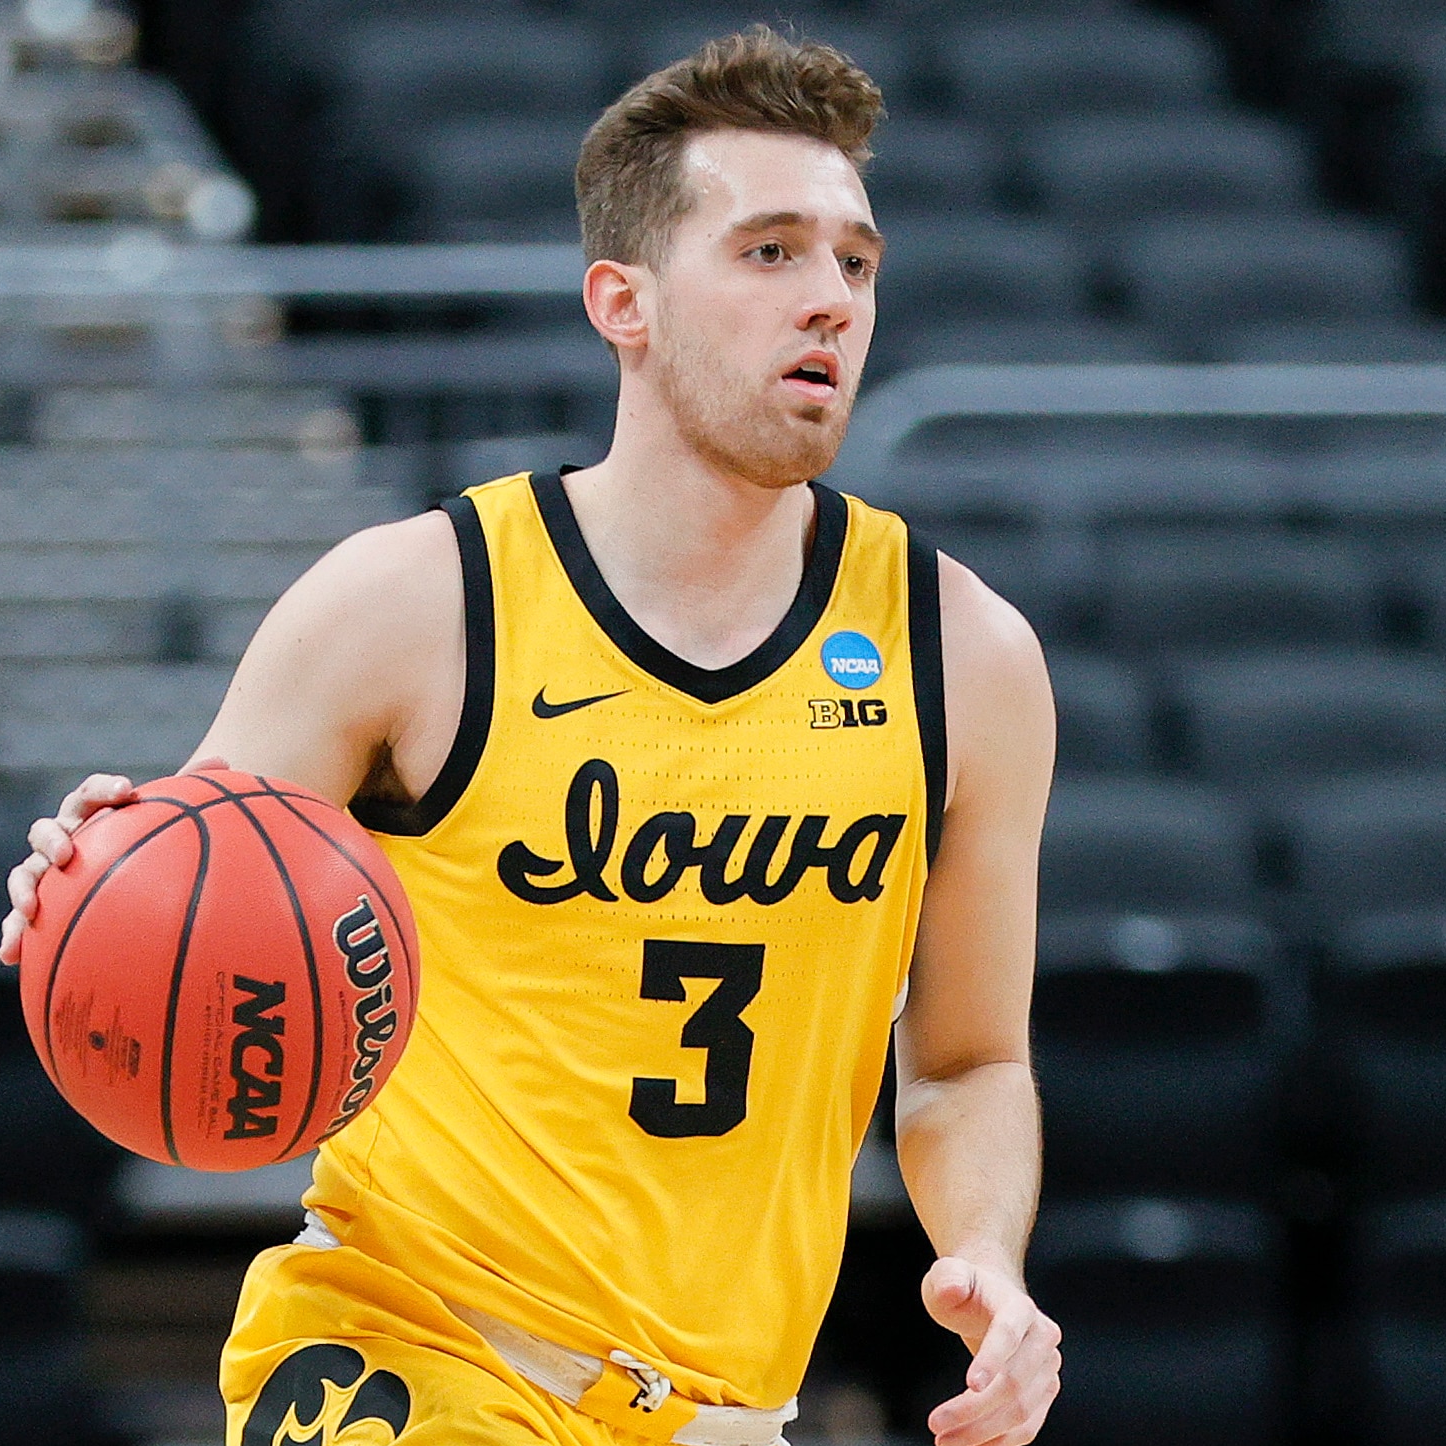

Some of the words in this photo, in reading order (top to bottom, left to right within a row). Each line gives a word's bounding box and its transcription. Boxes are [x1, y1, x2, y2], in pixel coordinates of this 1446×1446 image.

[831, 657, 880, 674] NCAA
[496, 758, 907, 905] Iowa
[223, 973, 287, 1140] NCAA
[628, 938, 766, 1139] 3
